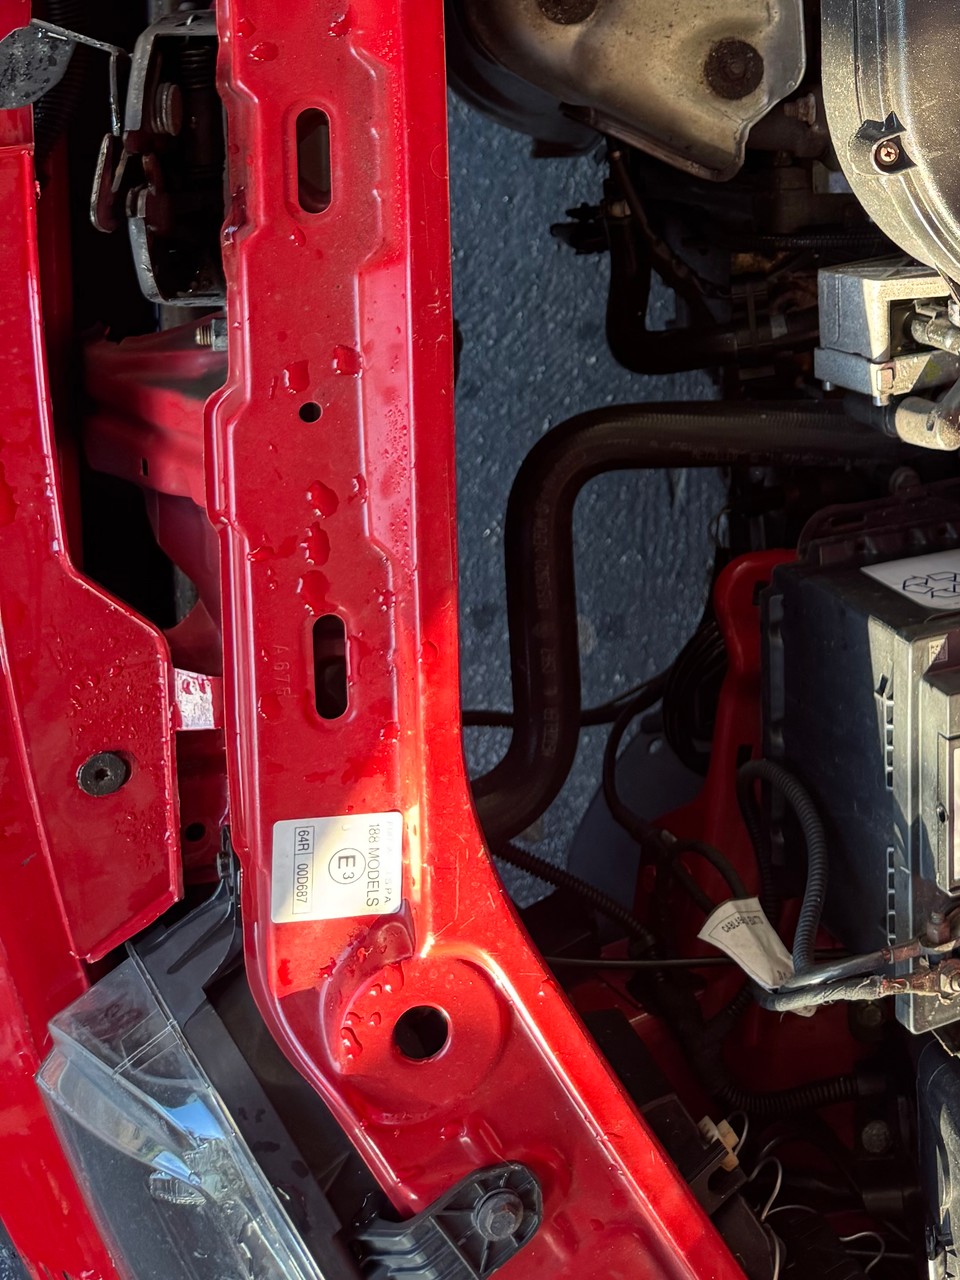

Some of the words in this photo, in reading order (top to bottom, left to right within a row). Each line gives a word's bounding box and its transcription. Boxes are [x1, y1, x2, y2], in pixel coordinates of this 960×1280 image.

[296, 829, 310, 852] 64R
[367, 822, 380, 843] 188
[337, 853, 356, 870] E
[342, 871, 354, 880] 3
[365, 846, 381, 907] MODELS
